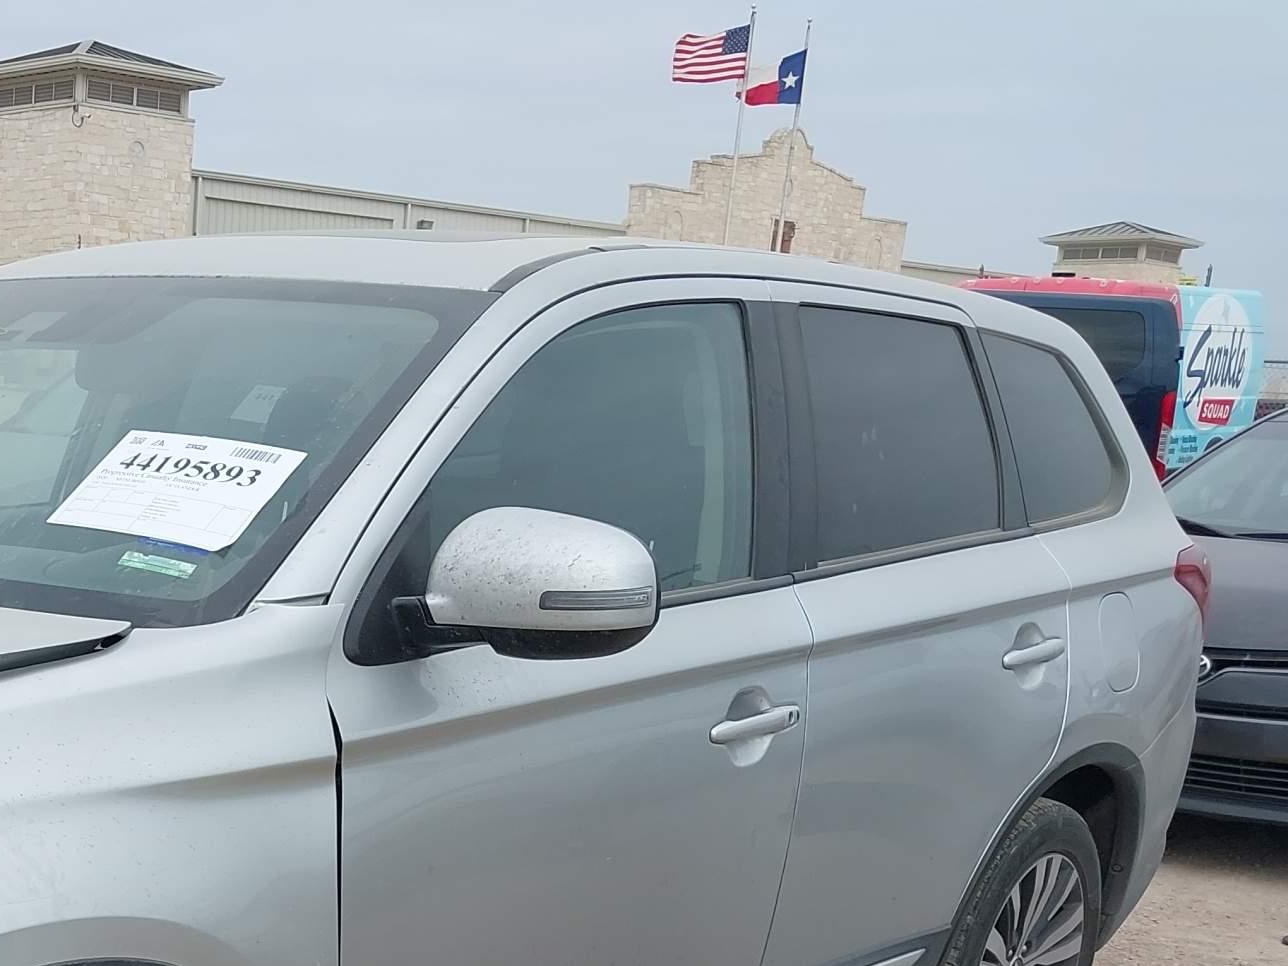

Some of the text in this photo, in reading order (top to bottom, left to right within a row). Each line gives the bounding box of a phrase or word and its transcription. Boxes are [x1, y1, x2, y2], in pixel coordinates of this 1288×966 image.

[1184, 324, 1246, 408] Sparkle
[1202, 403, 1230, 419] SQUAD
[119, 452, 262, 487] 44195893
